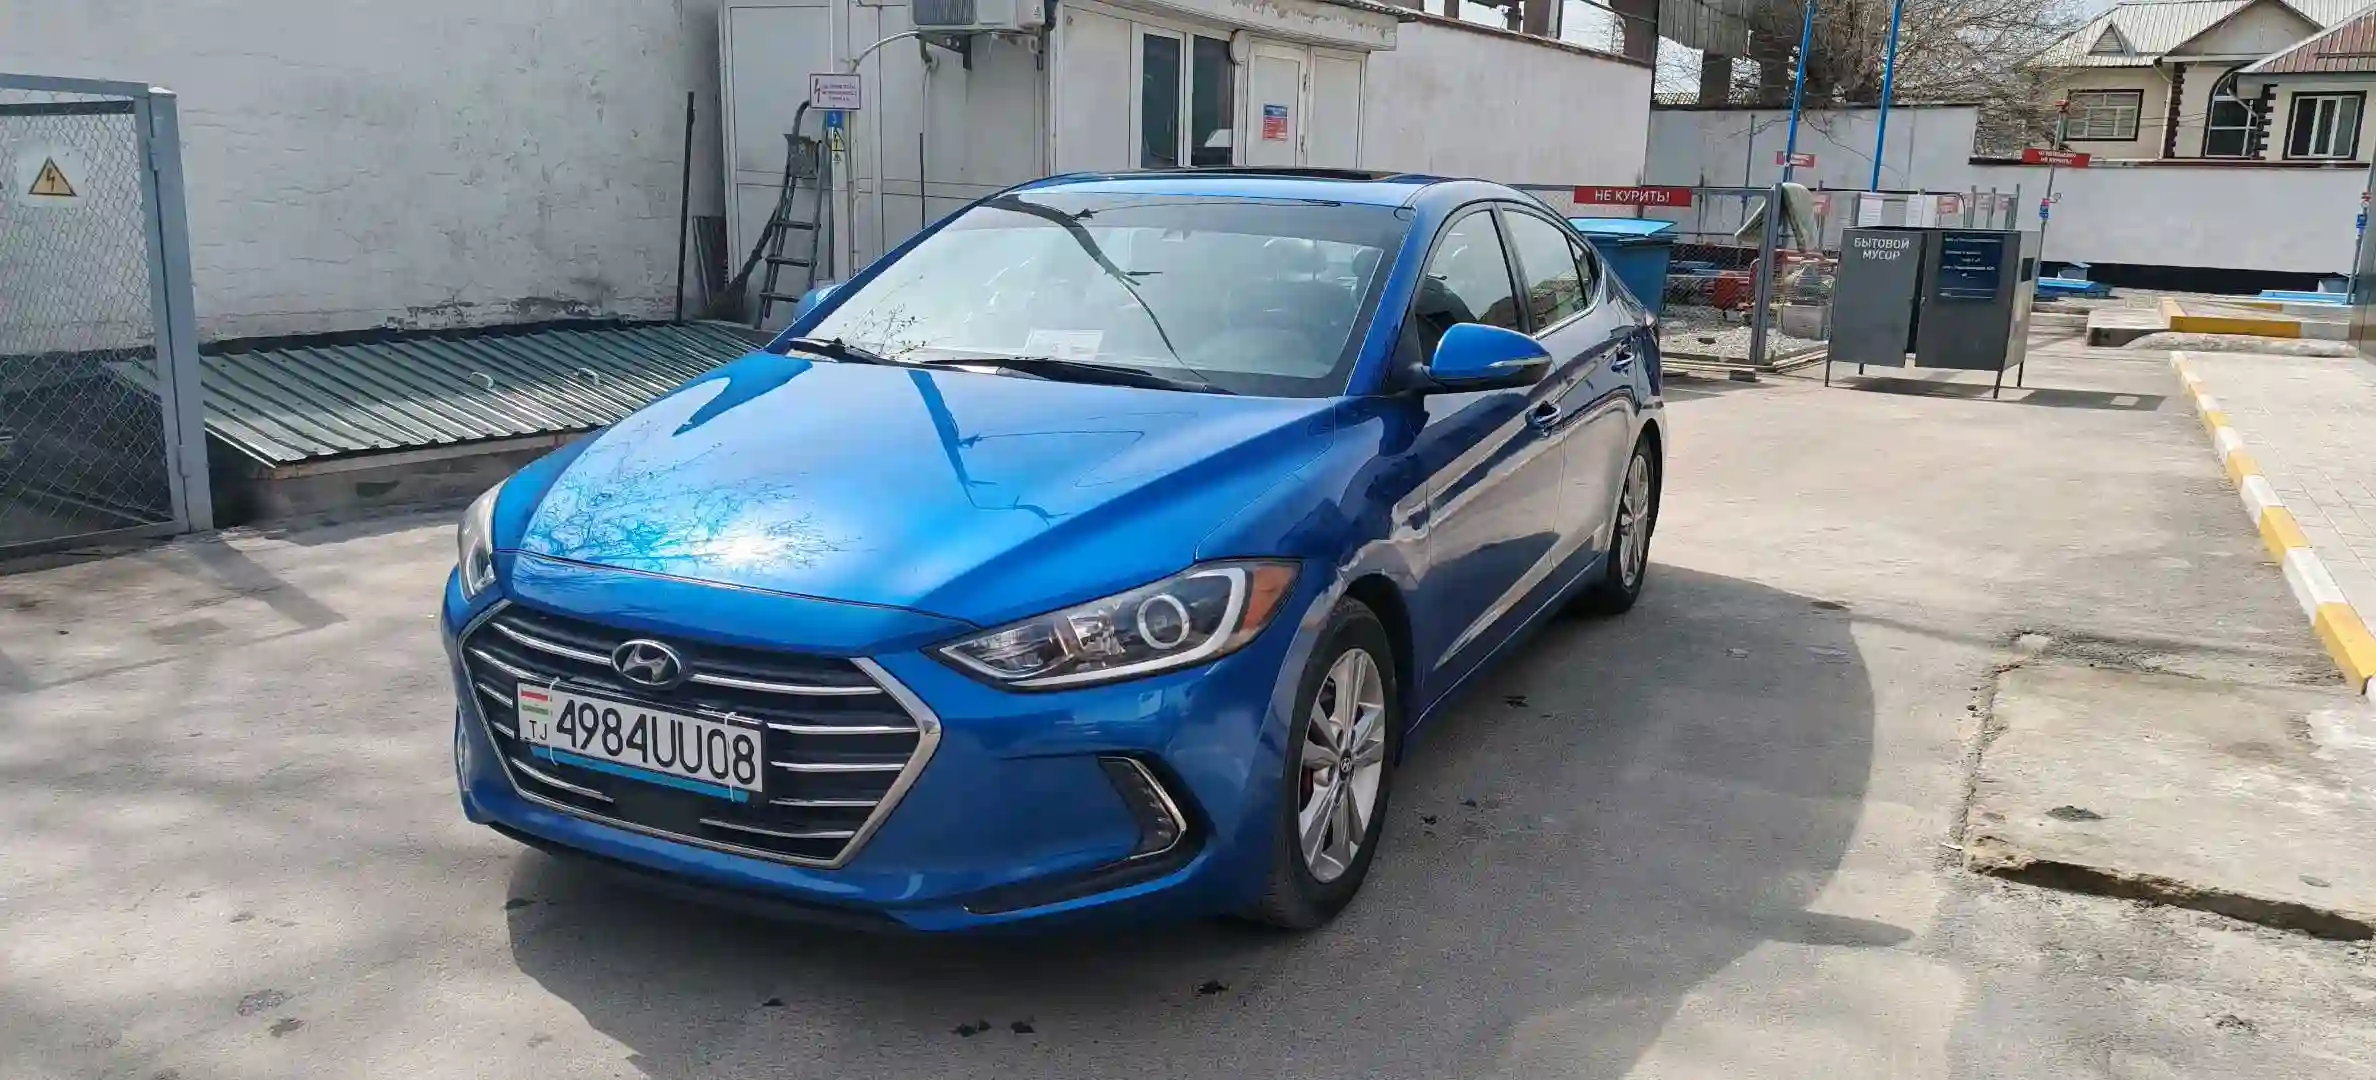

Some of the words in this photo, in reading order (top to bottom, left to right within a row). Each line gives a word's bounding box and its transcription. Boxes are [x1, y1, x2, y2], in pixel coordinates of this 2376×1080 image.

[1595, 189, 1611, 201] НЕ
[1616, 190, 1670, 203] КУРИТЬ!
[1854, 237, 1910, 249] БЫТОВОЙ
[1862, 249, 1901, 260] МУСОР
[529, 719, 548, 741] TJ
[556, 699, 756, 786] 4984UU08
